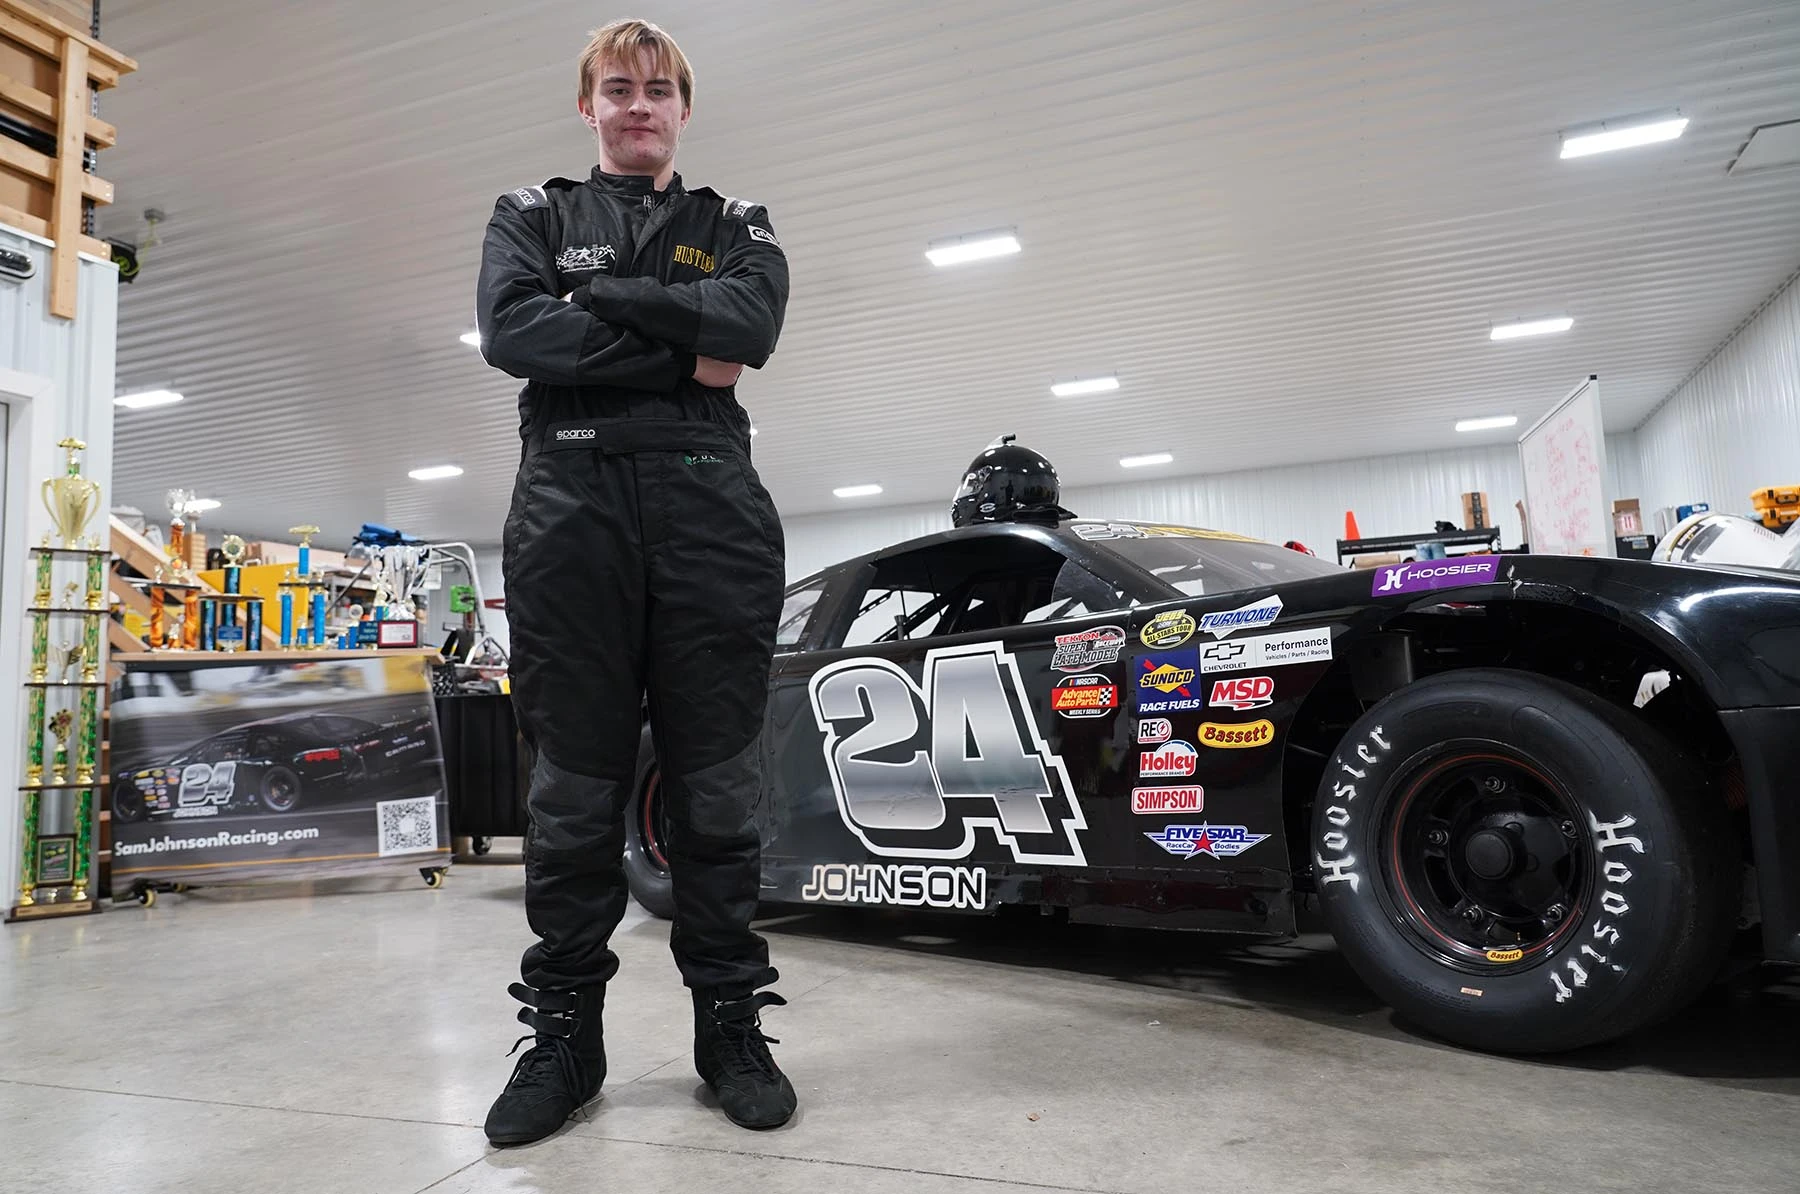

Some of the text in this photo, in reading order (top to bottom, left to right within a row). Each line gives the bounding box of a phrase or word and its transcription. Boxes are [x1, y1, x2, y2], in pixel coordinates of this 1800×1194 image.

[556, 428, 596, 441] sparco
[1407, 563, 1492, 581] HOOSIER
[1201, 606, 1280, 628] TURNONE
[1056, 631, 1100, 645] TEKTON
[1265, 637, 1329, 653] Performance
[1053, 647, 1118, 667] LATE MODEL
[1058, 642, 1088, 654] SUPER
[1265, 653, 1287, 661] Vehicles
[1310, 649, 1330, 657] Racing
[1203, 662, 1248, 672] CHEVROLET
[1142, 671, 1193, 687] SUNOCO
[1060, 689, 1098, 699] Advance
[1210, 677, 1274, 702] MSD
[1056, 698, 1076, 707] Auto
[1139, 699, 1200, 713] RACE FUELS
[1203, 724, 1268, 744] Bassett
[809, 643, 1084, 863] 24
[1141, 752, 1196, 775] Holley
[178, 761, 237, 807] 24
[1136, 790, 1198, 810] SIMPSON
[1316, 724, 1393, 893] Hoosier
[114, 826, 320, 857] SamJohnsonRacing.com
[1166, 828, 1246, 841] FIVE STAR
[803, 864, 987, 909] JOHNSON
[1549, 808, 1647, 1004] Hoosier
